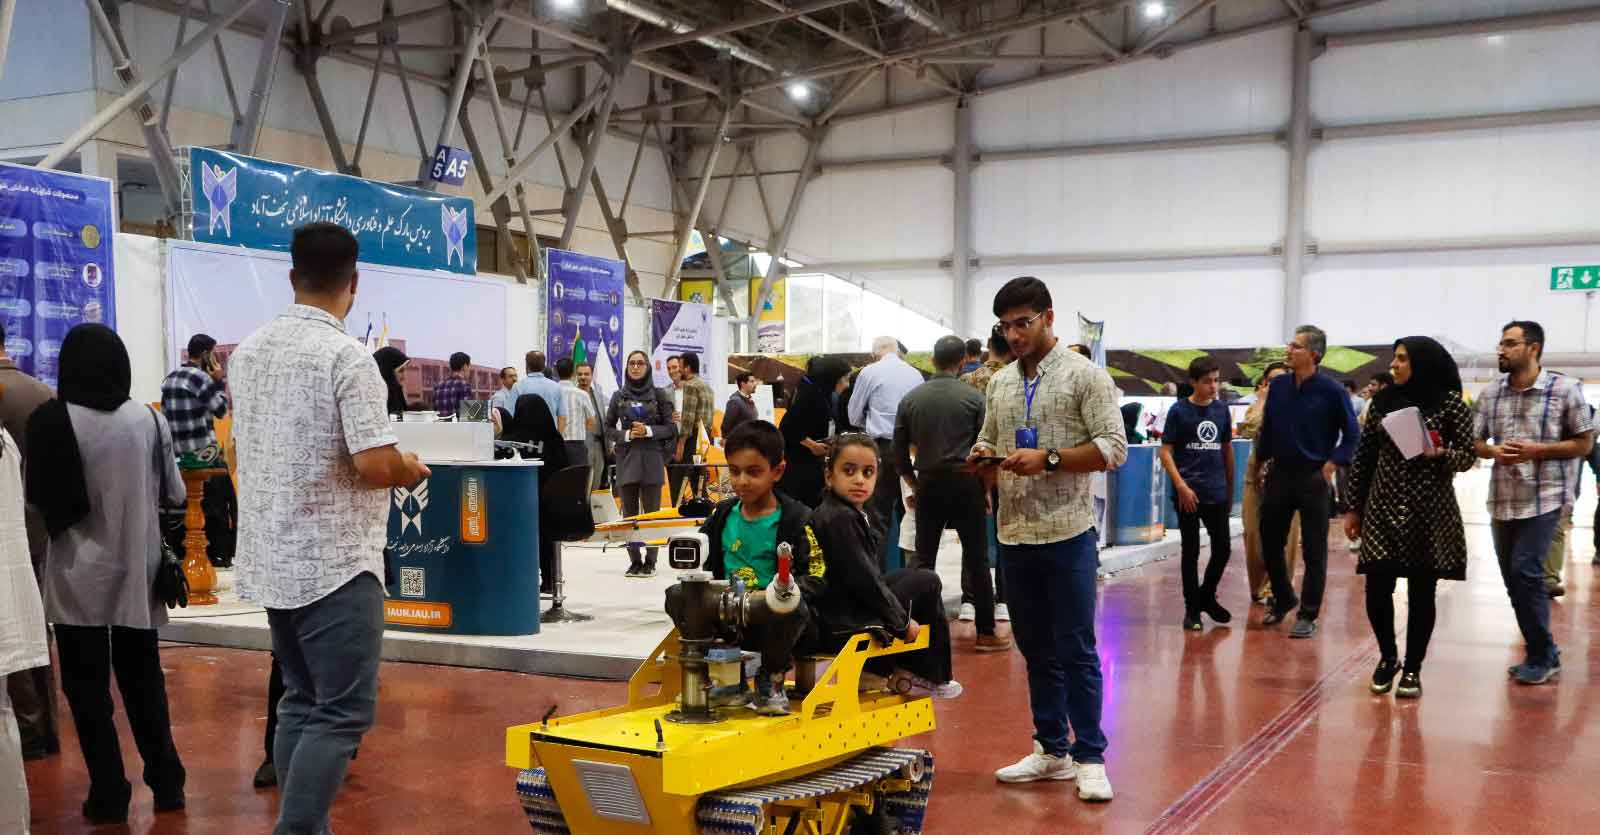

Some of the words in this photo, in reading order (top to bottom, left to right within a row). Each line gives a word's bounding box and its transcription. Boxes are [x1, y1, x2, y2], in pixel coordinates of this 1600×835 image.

[445, 157, 468, 178] A5
[251, 194, 272, 229] آباد
[265, 190, 289, 228] نجف
[286, 195, 314, 225] اسلامی
[333, 196, 352, 229] دانشگاه
[351, 208, 378, 236] فناوری
[381, 215, 395, 249] علم
[394, 203, 414, 252] پارک
[409, 224, 432, 254] پردیس
